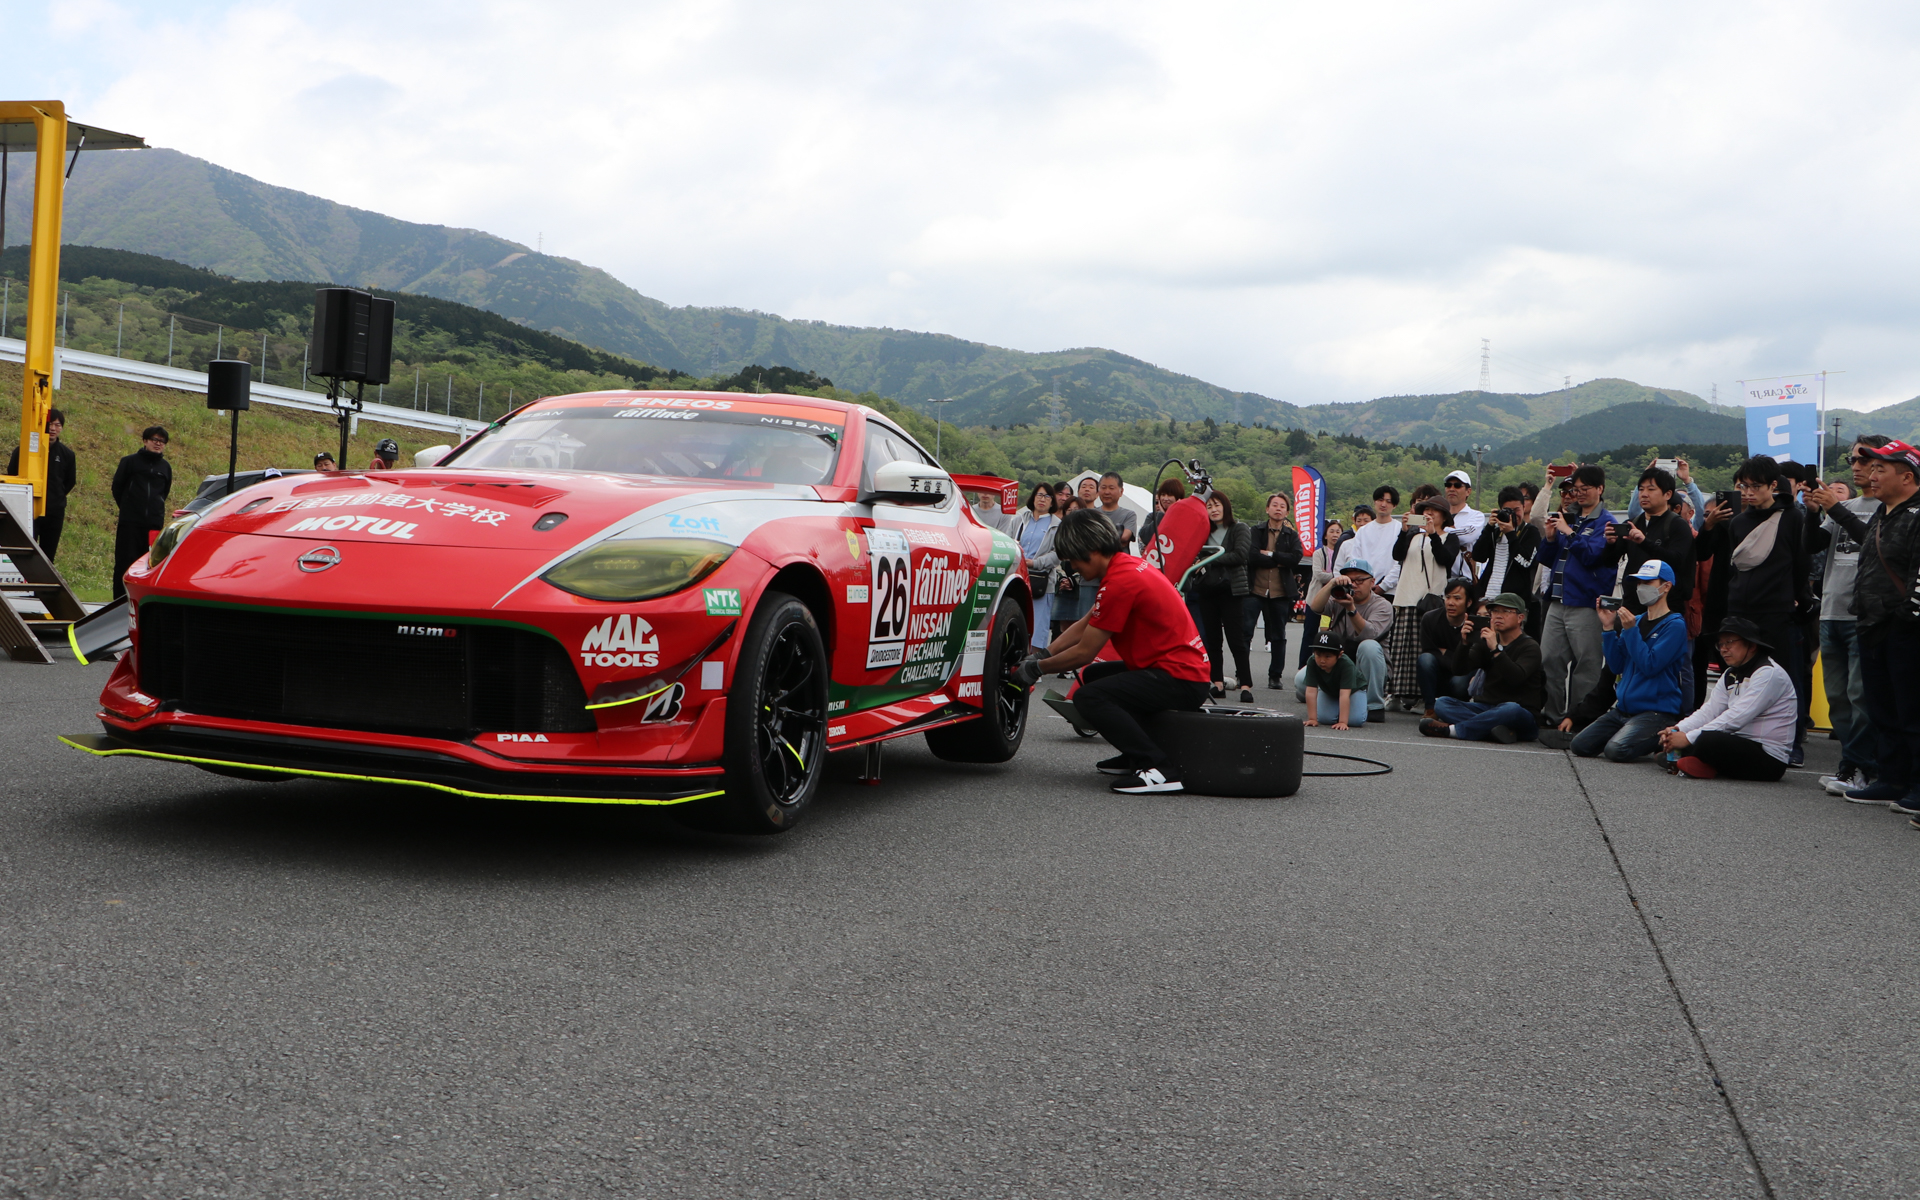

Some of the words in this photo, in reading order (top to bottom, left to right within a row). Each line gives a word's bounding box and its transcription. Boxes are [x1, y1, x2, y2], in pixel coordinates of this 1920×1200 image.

[630, 397, 734, 411] ENEOS
[613, 407, 699, 421] raffinée
[761, 417, 836, 433] NISSAN
[267, 494, 511, 527] 日産自動車大学校
[286, 515, 419, 540] MOTUL
[665, 514, 720, 531] Zoff
[298, 555, 340, 563] NISSAN
[912, 552, 970, 606] raffinée
[705, 590, 739, 607] NTK
[875, 556, 907, 638] 26
[397, 625, 457, 638] nismo
[909, 612, 953, 640] NISSAN
[580, 652, 660, 668] TOOLS
[869, 649, 902, 664] BRIDGESTONE
[904, 641, 947, 663] MECHANIC
[900, 662, 942, 684] CHALLENGE
[957, 681, 982, 698] MOTUL
[497, 733, 549, 743] PIAA
